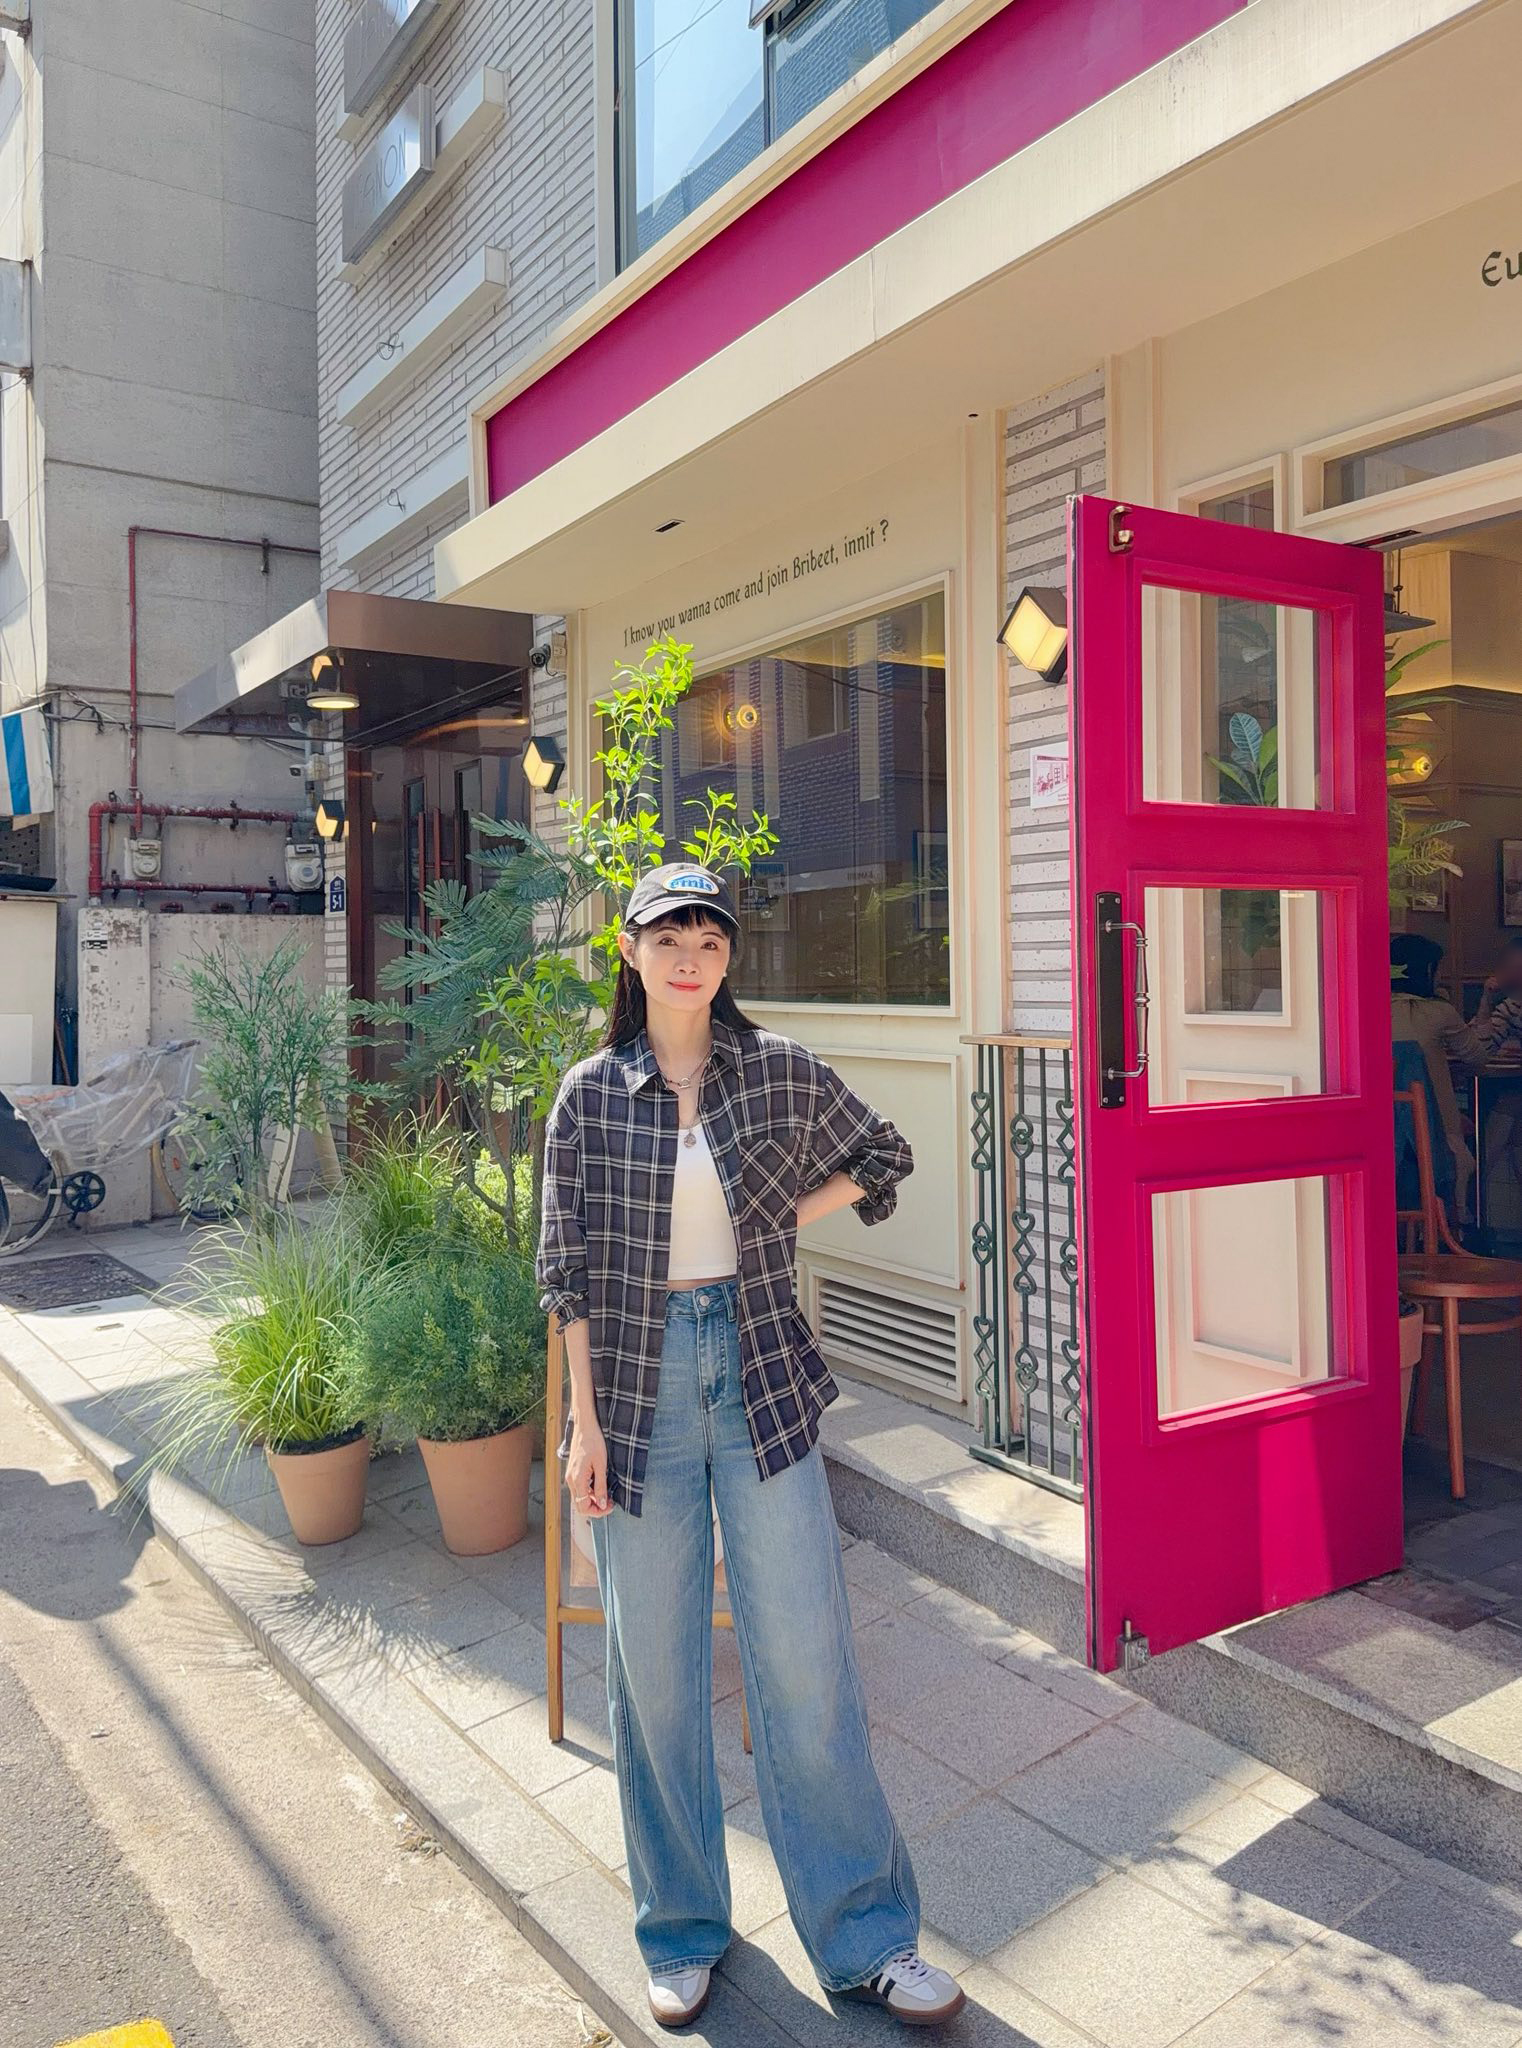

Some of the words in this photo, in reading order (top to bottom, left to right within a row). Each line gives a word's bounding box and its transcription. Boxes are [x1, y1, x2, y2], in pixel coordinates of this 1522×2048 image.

[1481, 250, 1522, 287] Eu
[623, 628, 628, 647] I
[630, 624, 655, 645] know
[658, 616, 676, 640] you
[678, 600, 711, 625] wanna
[714, 588, 741, 611] come
[744, 571, 764, 599] and
[767, 565, 789, 596] join
[793, 544, 839, 579] Bribeet,
[844, 526, 876, 557] innit
[332, 893, 343, 910] 5-1
